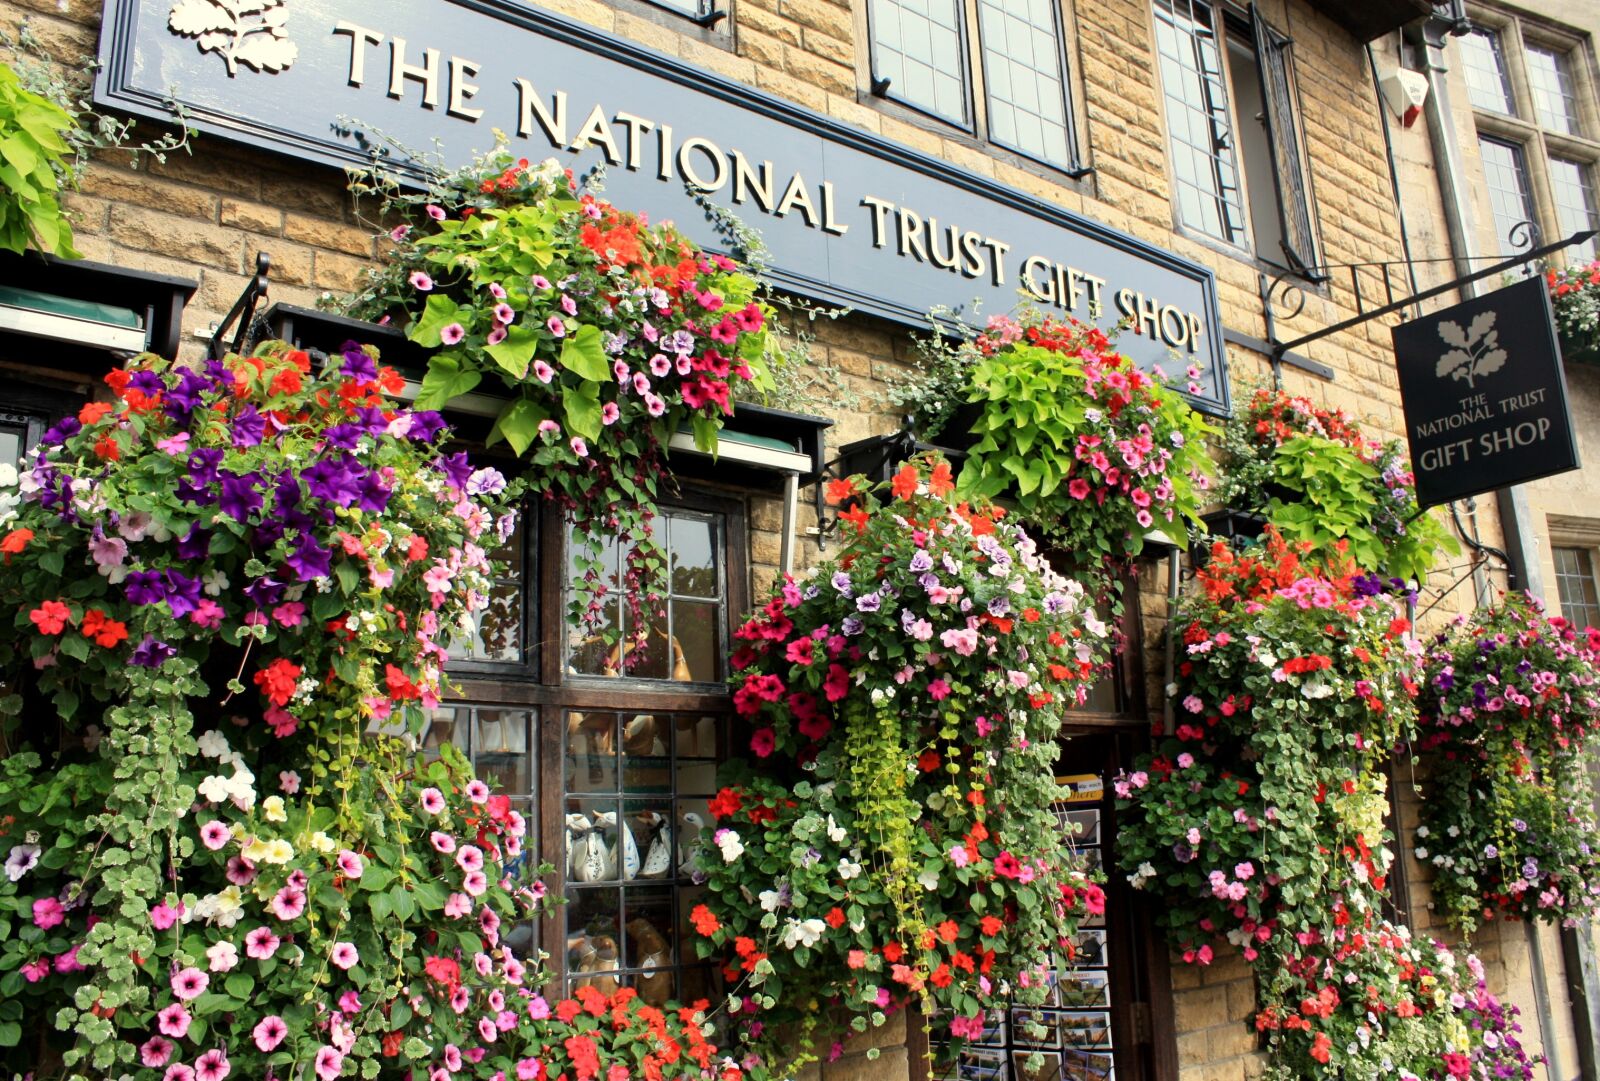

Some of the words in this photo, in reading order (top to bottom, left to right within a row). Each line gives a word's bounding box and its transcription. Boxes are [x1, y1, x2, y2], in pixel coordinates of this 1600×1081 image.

[333, 20, 484, 120] THE
[514, 77, 848, 235] NATIONAL
[862, 195, 1010, 286] TRUST
[1021, 255, 1106, 319] GIFT
[1117, 287, 1202, 352] SHOP
[1417, 406, 1494, 438] NATIONAL
[1499, 389, 1546, 413] TRUST
[1460, 394, 1487, 410] THE
[1421, 440, 1473, 471] GIFT
[1480, 418, 1550, 456] SHOP
